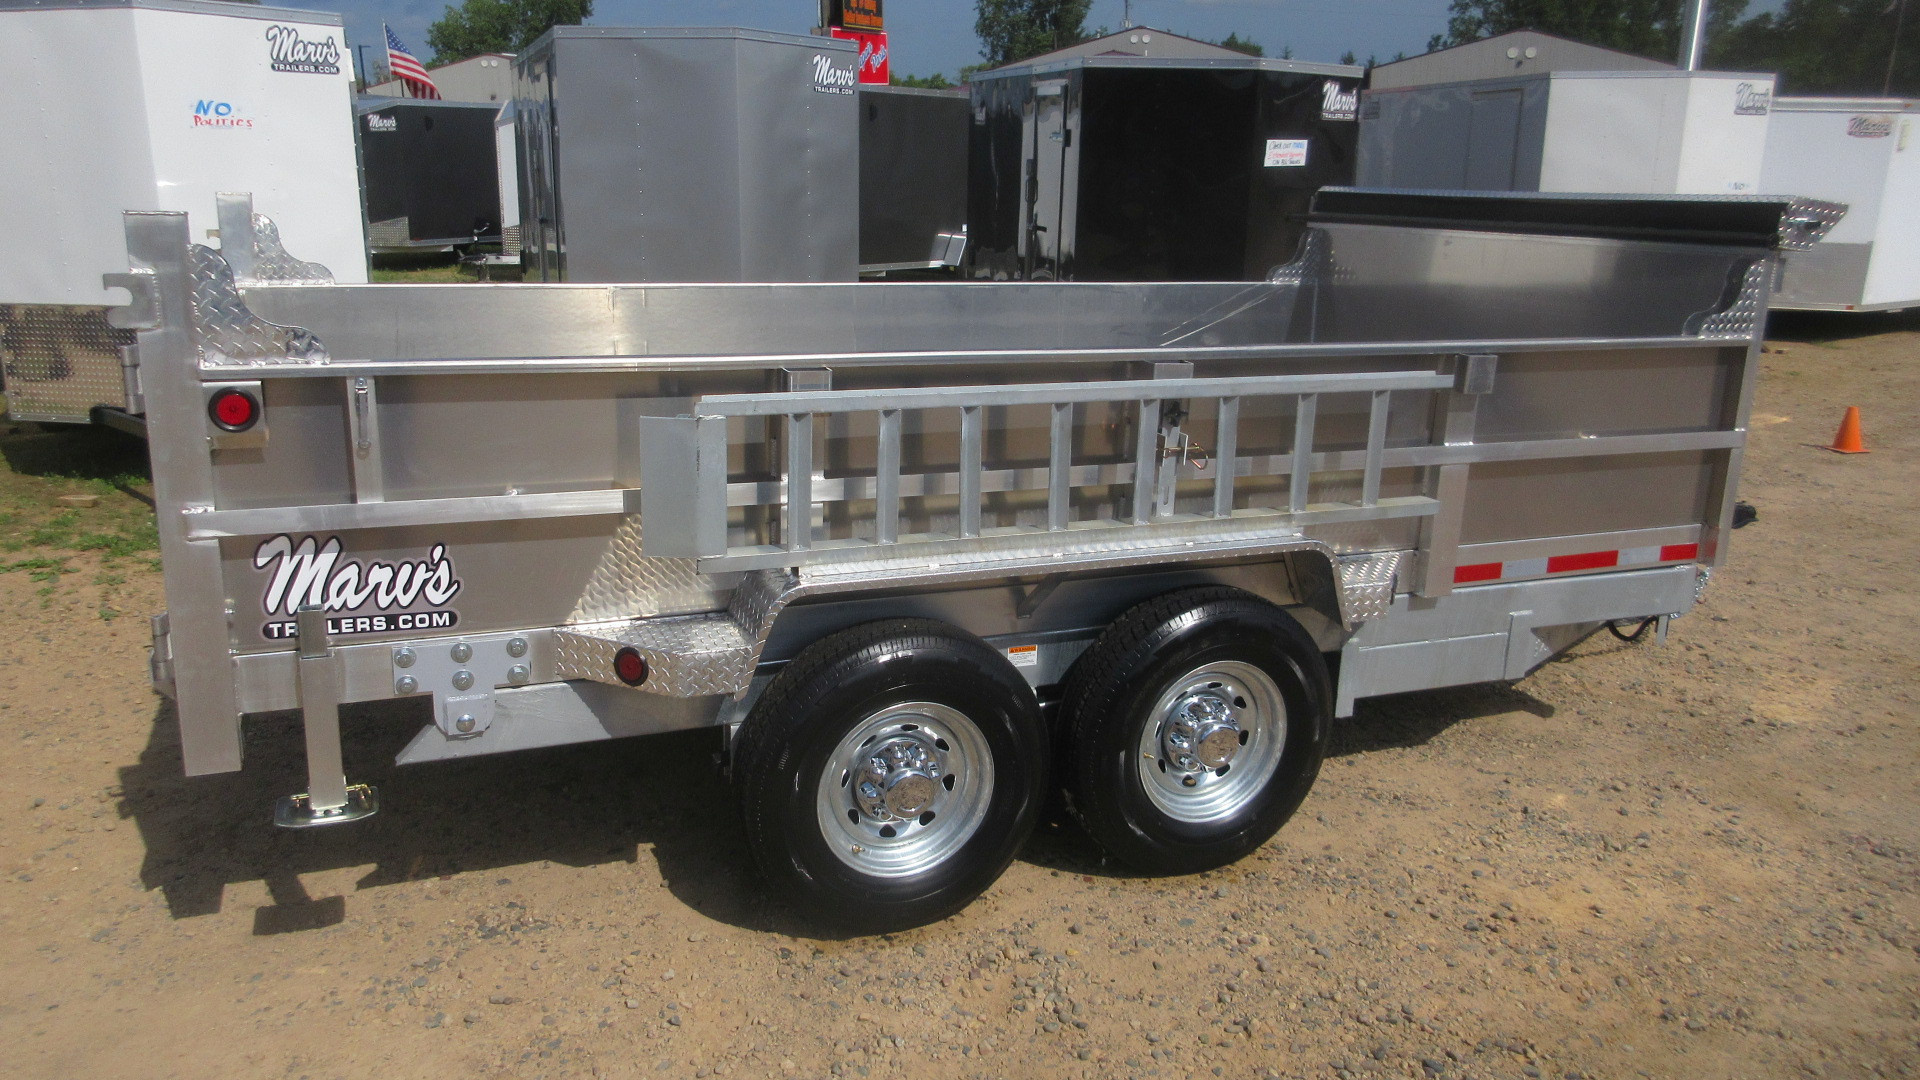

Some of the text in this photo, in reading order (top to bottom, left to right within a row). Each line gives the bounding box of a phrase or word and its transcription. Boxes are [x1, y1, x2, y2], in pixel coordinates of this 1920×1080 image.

[267, 26, 340, 64] Marv's
[273, 63, 338, 74] TRAILERS.COM
[813, 54, 855, 87] Marv's
[814, 86, 854, 95] TRAILERS.COM
[1323, 82, 1357, 111] Marv's
[195, 100, 232, 116] NO
[368, 114, 397, 127] Marv's
[255, 534, 460, 615] Marv's
[269, 612, 450, 638] TRLERS.COM
